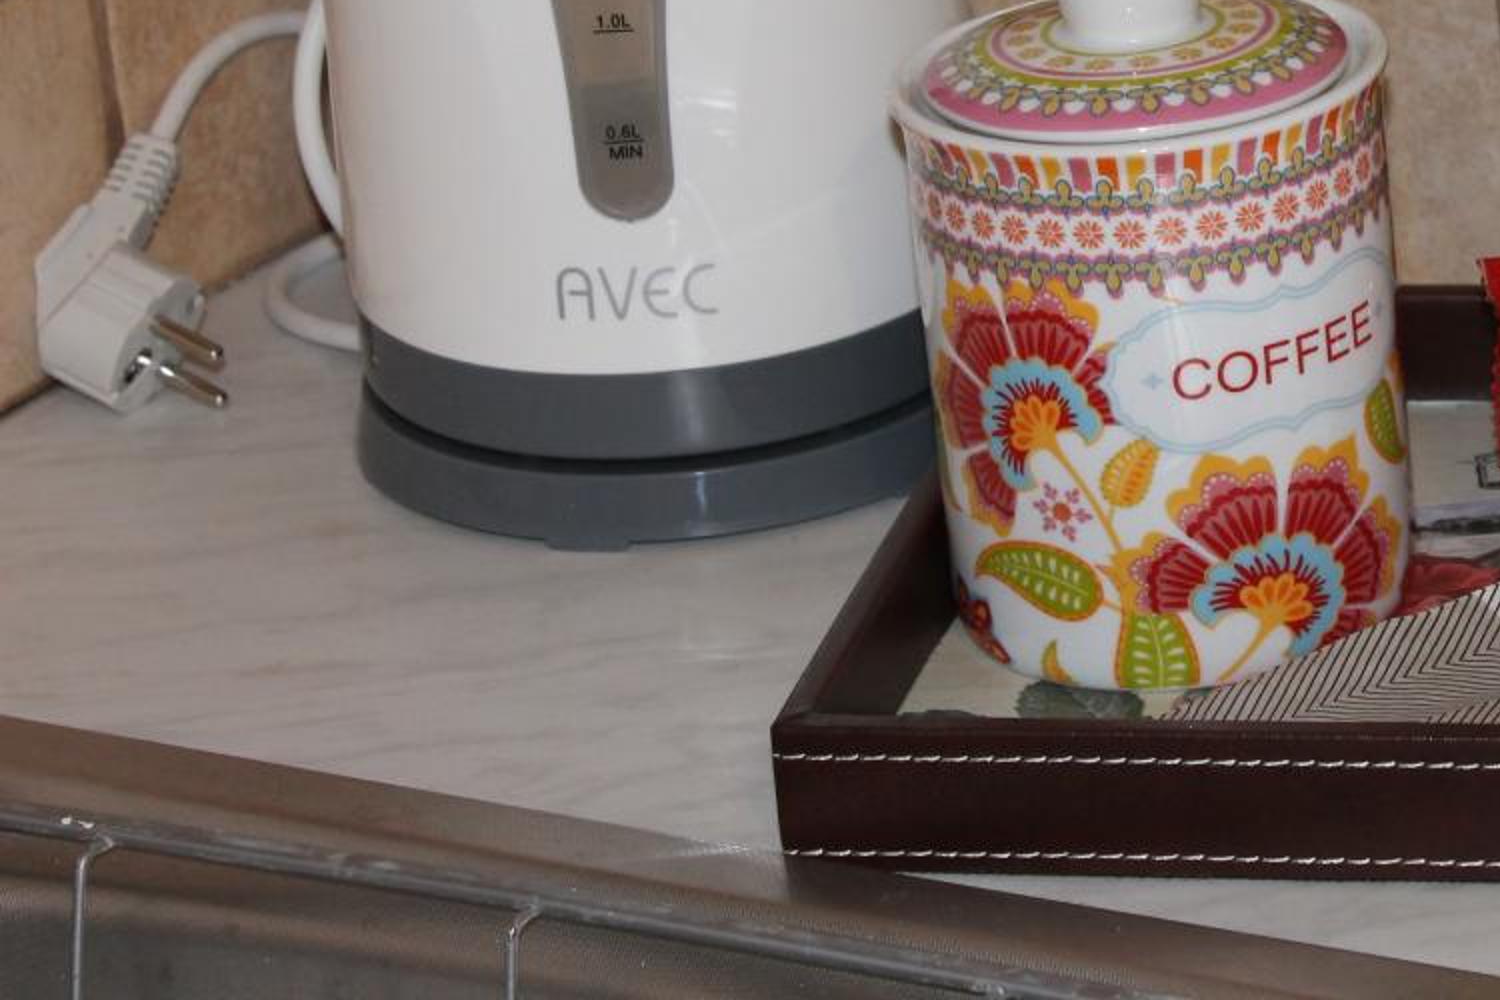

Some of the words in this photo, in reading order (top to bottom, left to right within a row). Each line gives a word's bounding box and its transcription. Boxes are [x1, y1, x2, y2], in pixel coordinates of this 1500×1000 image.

[596, 13, 631, 29] 1.0L
[608, 145, 644, 160] MIN
[556, 263, 719, 321] AVEC
[1172, 300, 1374, 401] COFFEE
